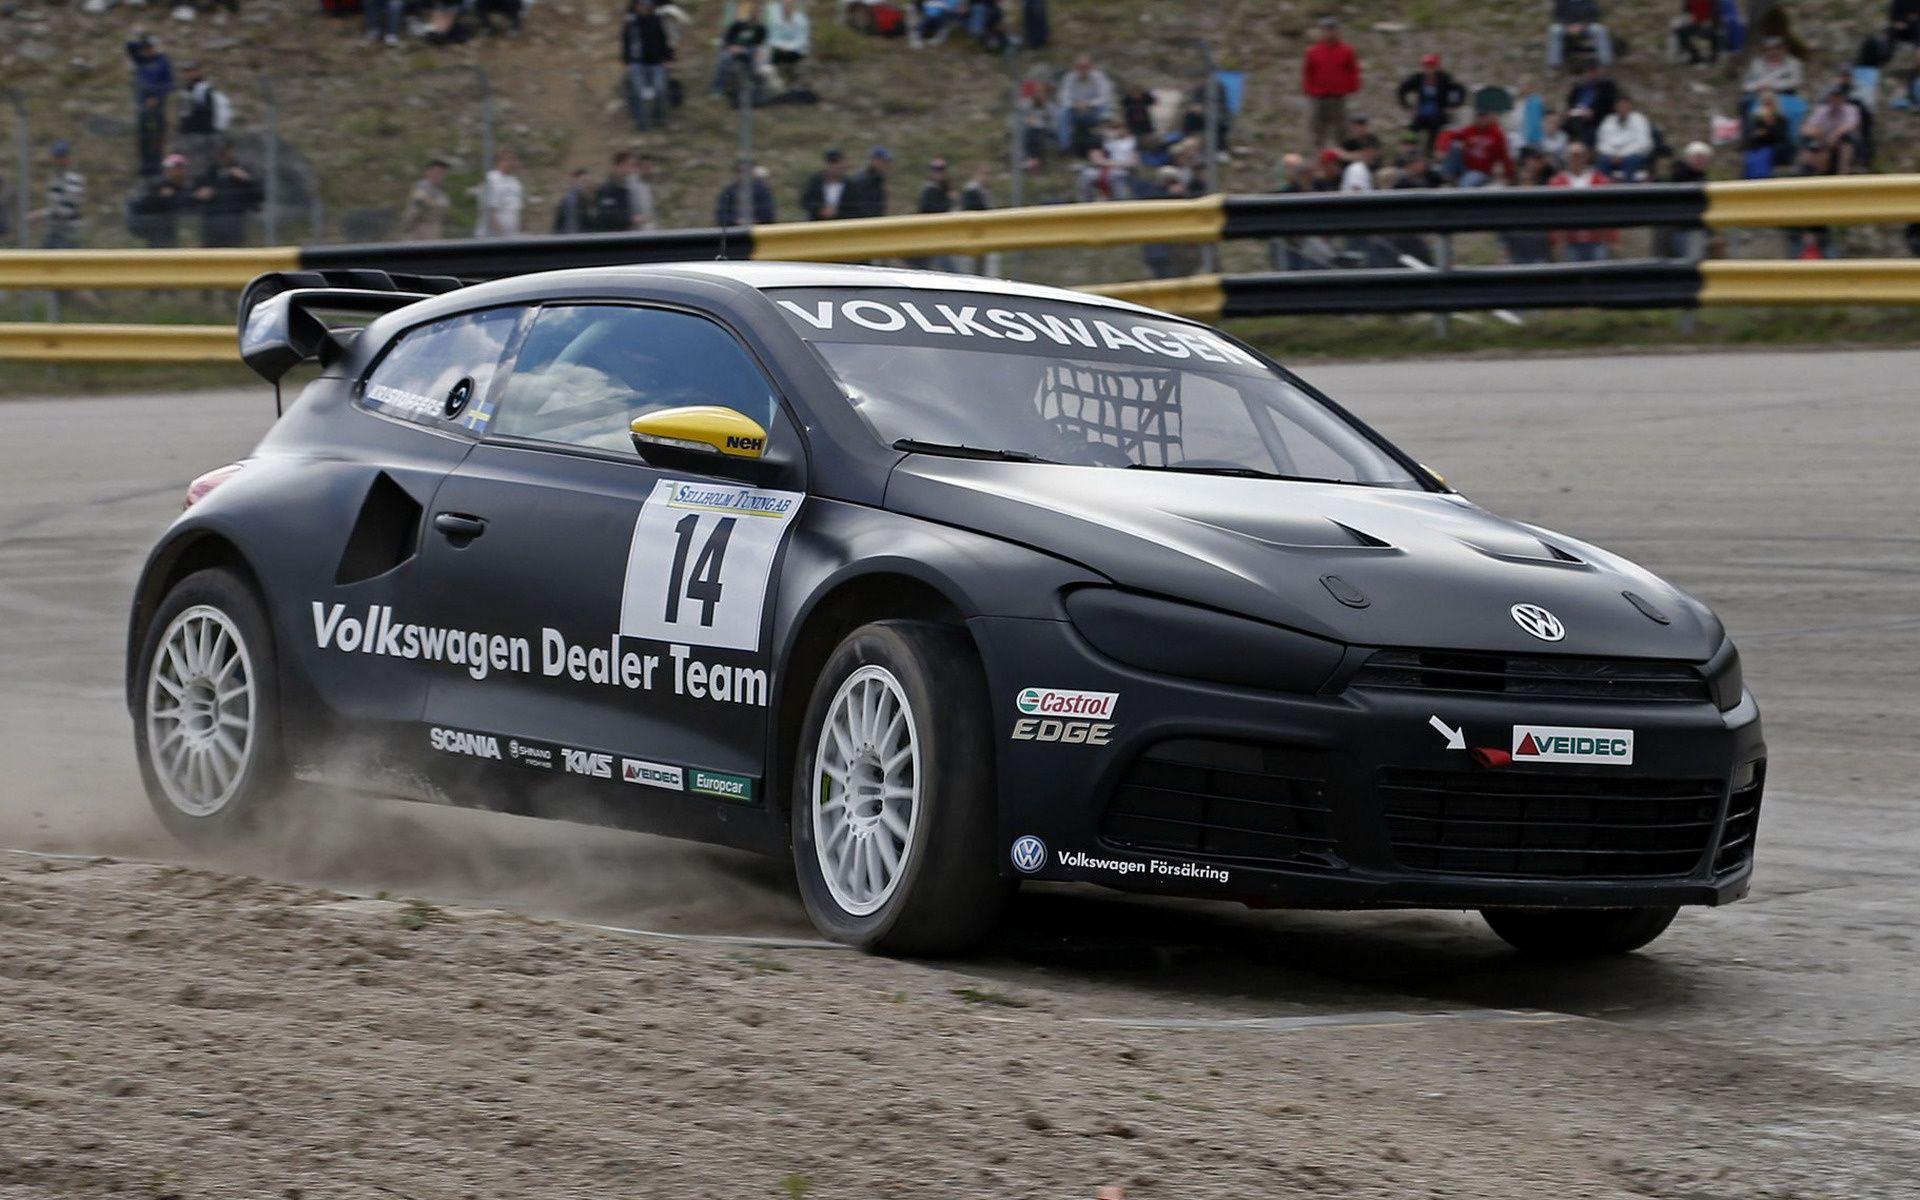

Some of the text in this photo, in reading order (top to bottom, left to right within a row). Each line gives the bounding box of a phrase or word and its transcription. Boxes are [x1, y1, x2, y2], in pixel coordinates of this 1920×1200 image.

[777, 300, 1269, 369] VOLKSWAGEN
[674, 485, 792, 512] SELLHOLM TUNING AB
[665, 513, 738, 627] 14
[312, 601, 768, 706] Volkswagen Dealer Team
[1039, 692, 1110, 715] Castrol
[430, 727, 502, 760] SCANIA
[1011, 718, 1118, 745] EDGE
[1533, 735, 1627, 756] VEIDEC
[561, 748, 613, 778] KMS
[697, 773, 743, 795] Europcar
[1057, 850, 1230, 883] Volkswagen Försäkring
